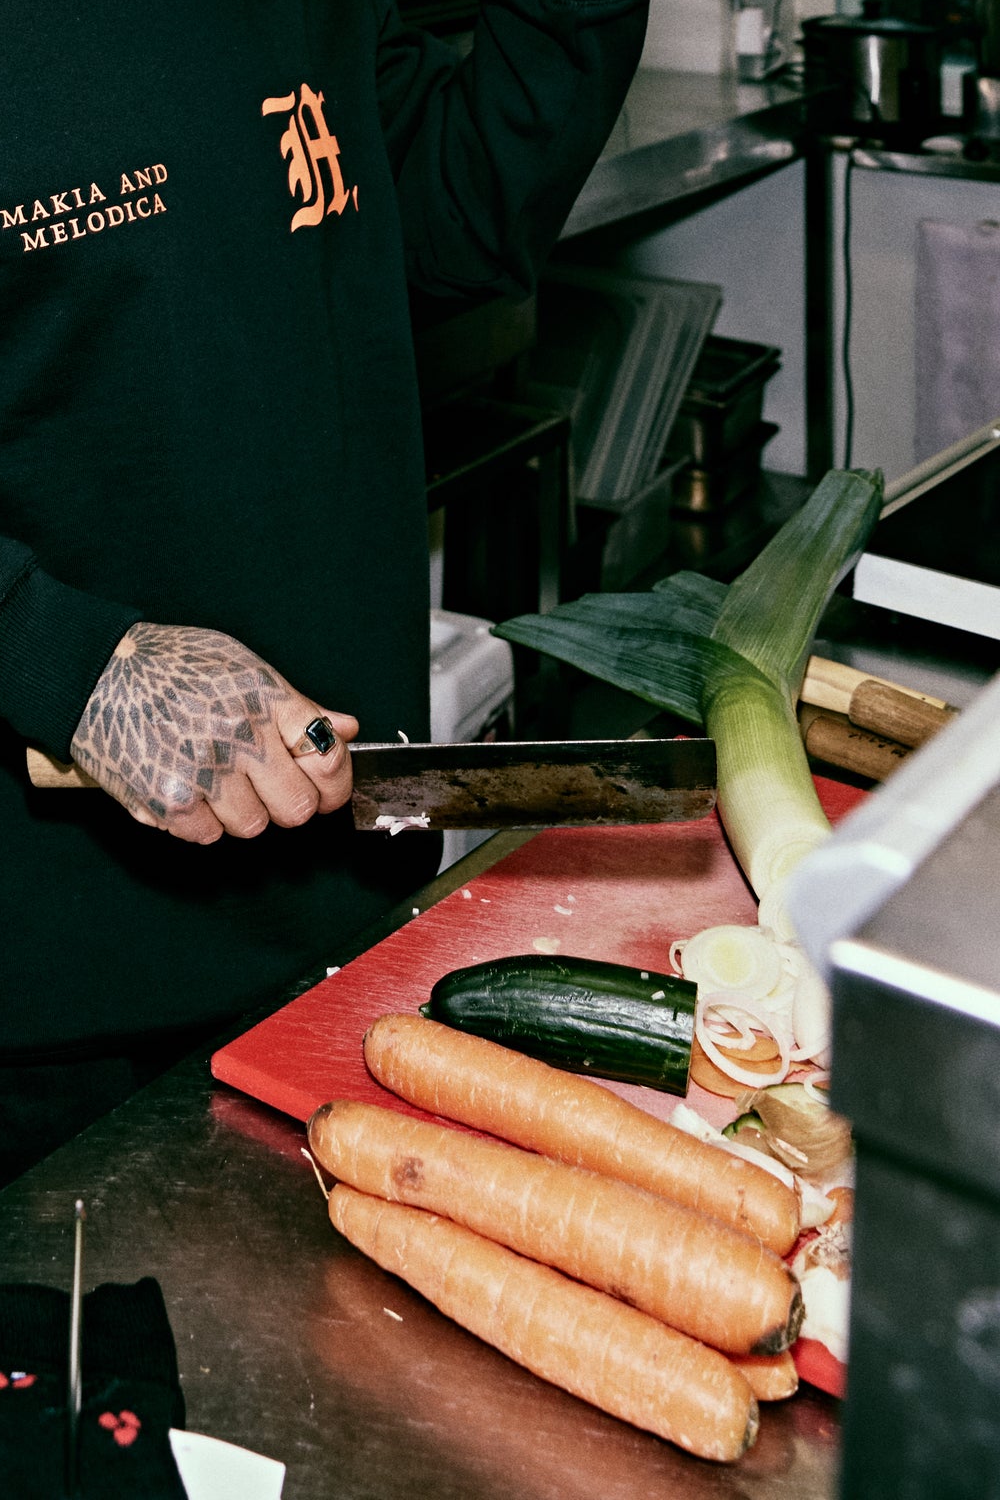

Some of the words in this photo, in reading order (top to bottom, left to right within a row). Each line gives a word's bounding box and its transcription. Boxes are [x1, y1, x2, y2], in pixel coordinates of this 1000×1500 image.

[0, 182, 107, 229] MAKIA
[120, 163, 168, 195] AND
[20, 193, 168, 252] MELODICA
